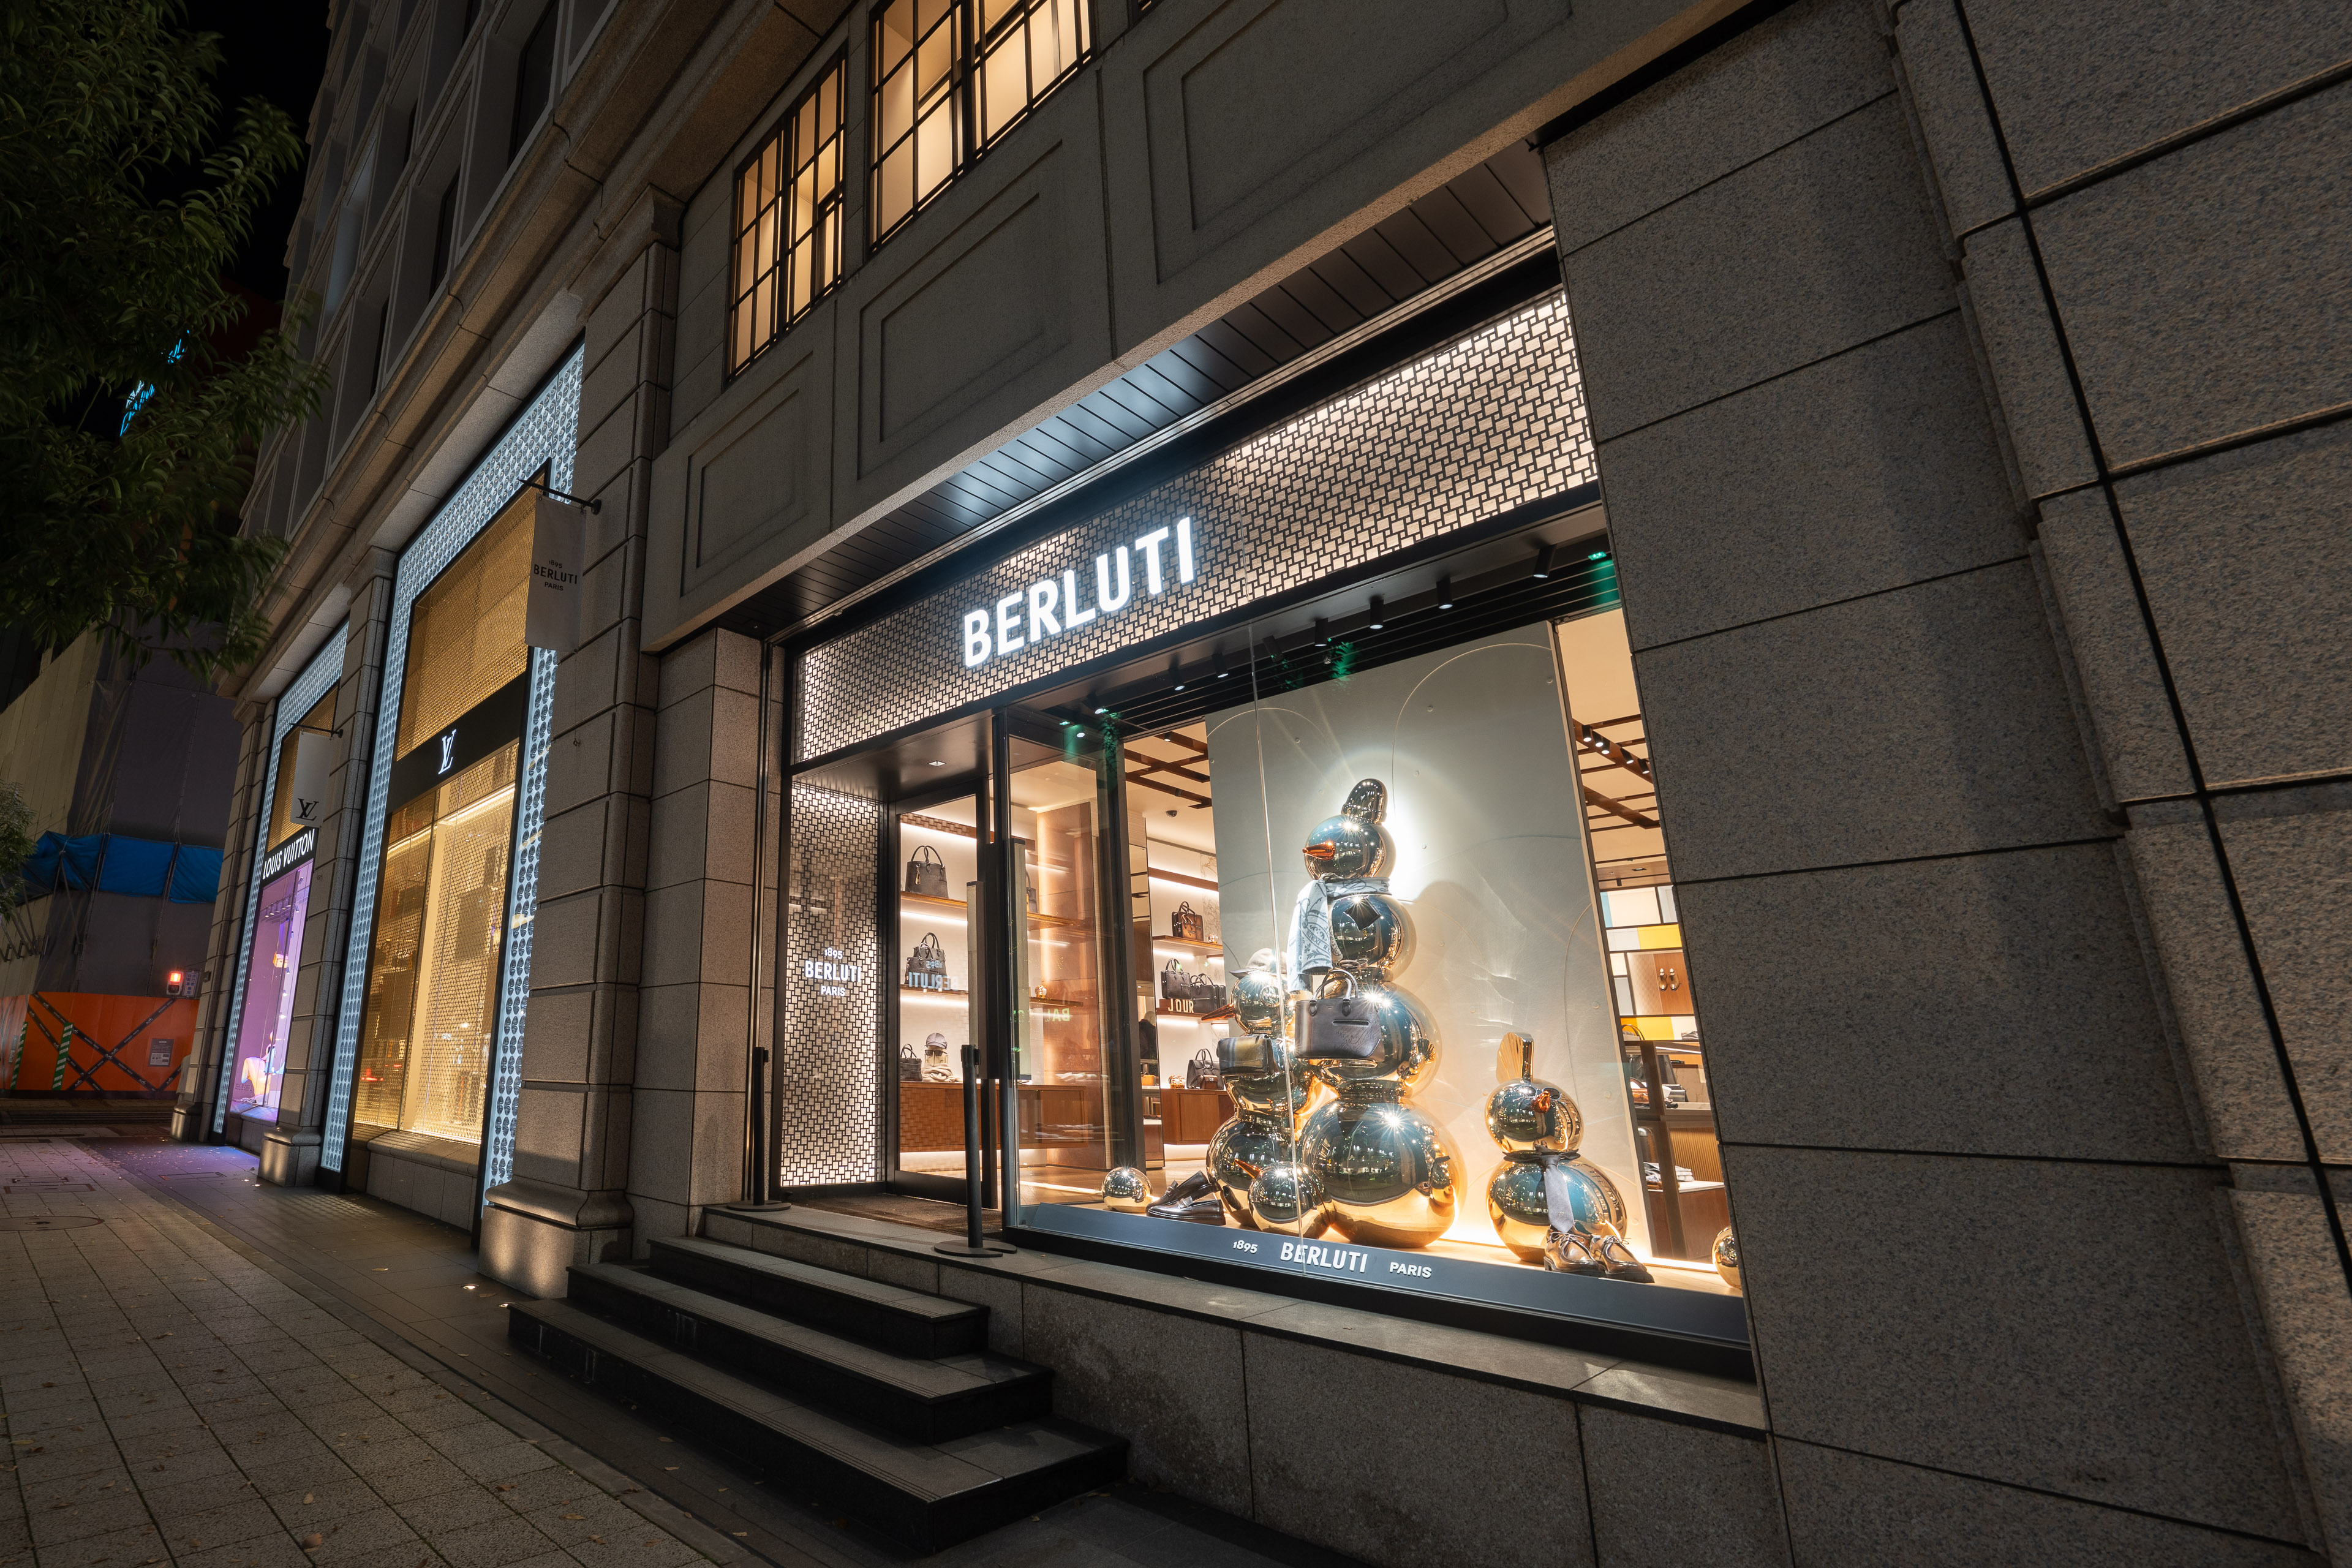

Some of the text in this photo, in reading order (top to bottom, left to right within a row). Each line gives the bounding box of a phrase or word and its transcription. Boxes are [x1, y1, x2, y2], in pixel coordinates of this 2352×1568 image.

[548, 559, 563, 569] 1895
[533, 564, 578, 584] BERLUTI
[545, 581, 564, 591] PARIS
[963, 516, 1196, 668] BERLUTI
[263, 828, 315, 880] LOUIS VUITTON
[824, 947, 843, 960] 1895
[805, 960, 862, 982] BERLUTI
[821, 986, 846, 997] PARIS
[1168, 998, 1194, 1013] JOUR
[1232, 1239, 1432, 1278] 1895 BERLUTI PARIS
